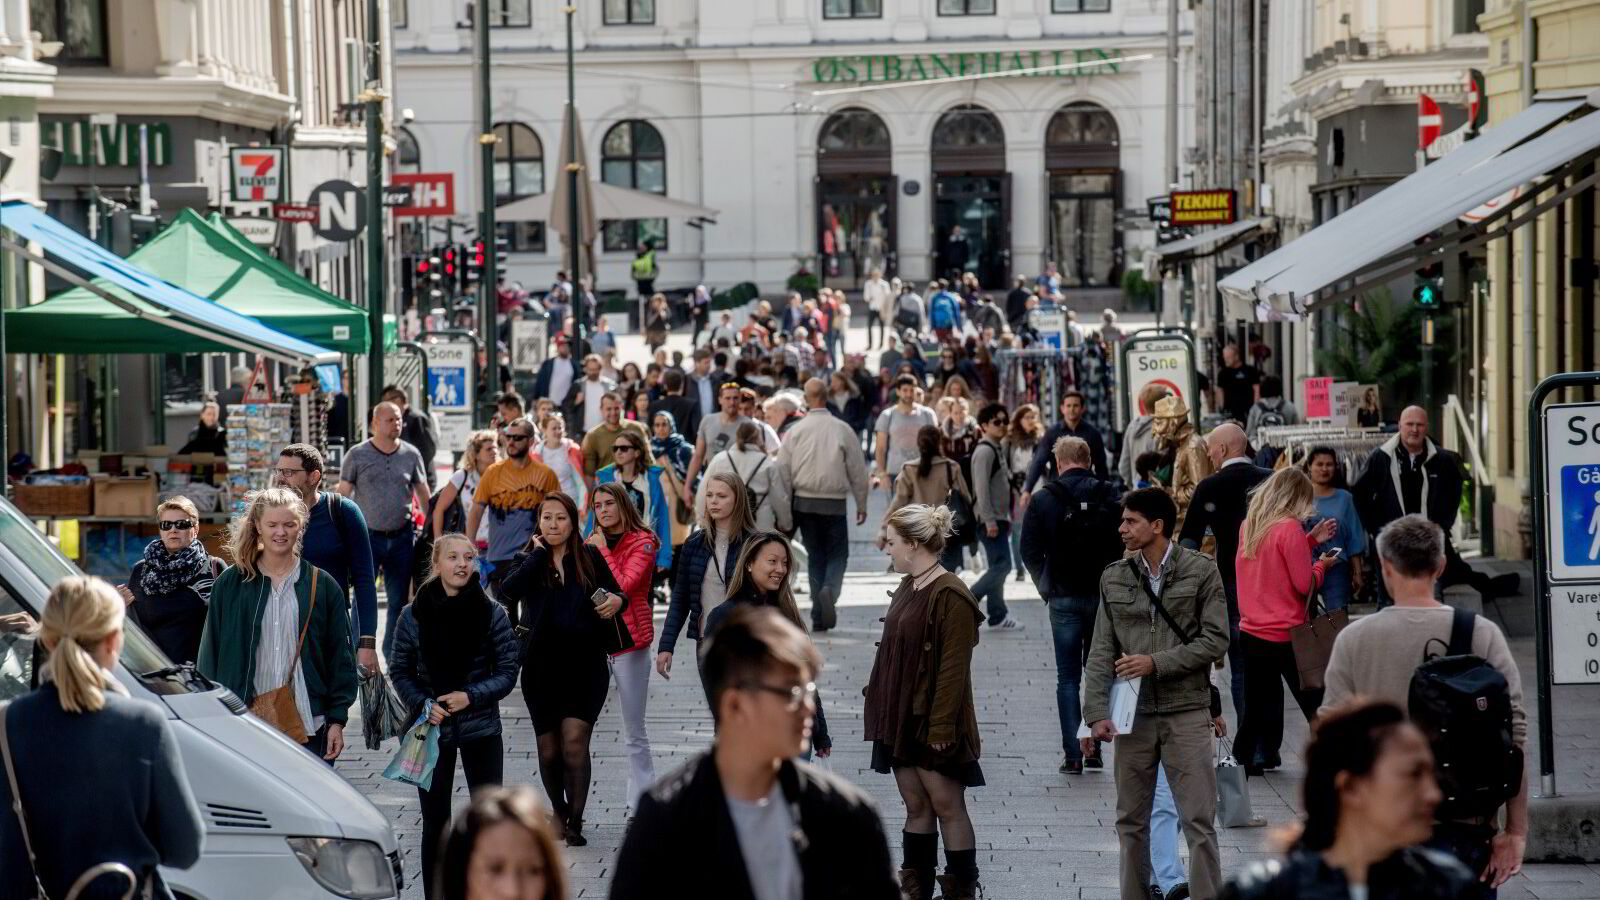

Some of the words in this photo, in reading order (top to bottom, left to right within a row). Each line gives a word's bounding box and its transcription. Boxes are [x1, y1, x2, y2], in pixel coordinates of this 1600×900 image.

[812, 48, 1121, 84] ØSTBANEHALLEN
[239, 153, 275, 202] 7
[1174, 193, 1229, 209] TEKNIK
[319, 190, 357, 231] N
[1174, 209, 1229, 221] MAGASINET
[429, 346, 463, 360] Sone
[1138, 355, 1178, 372] Sone
